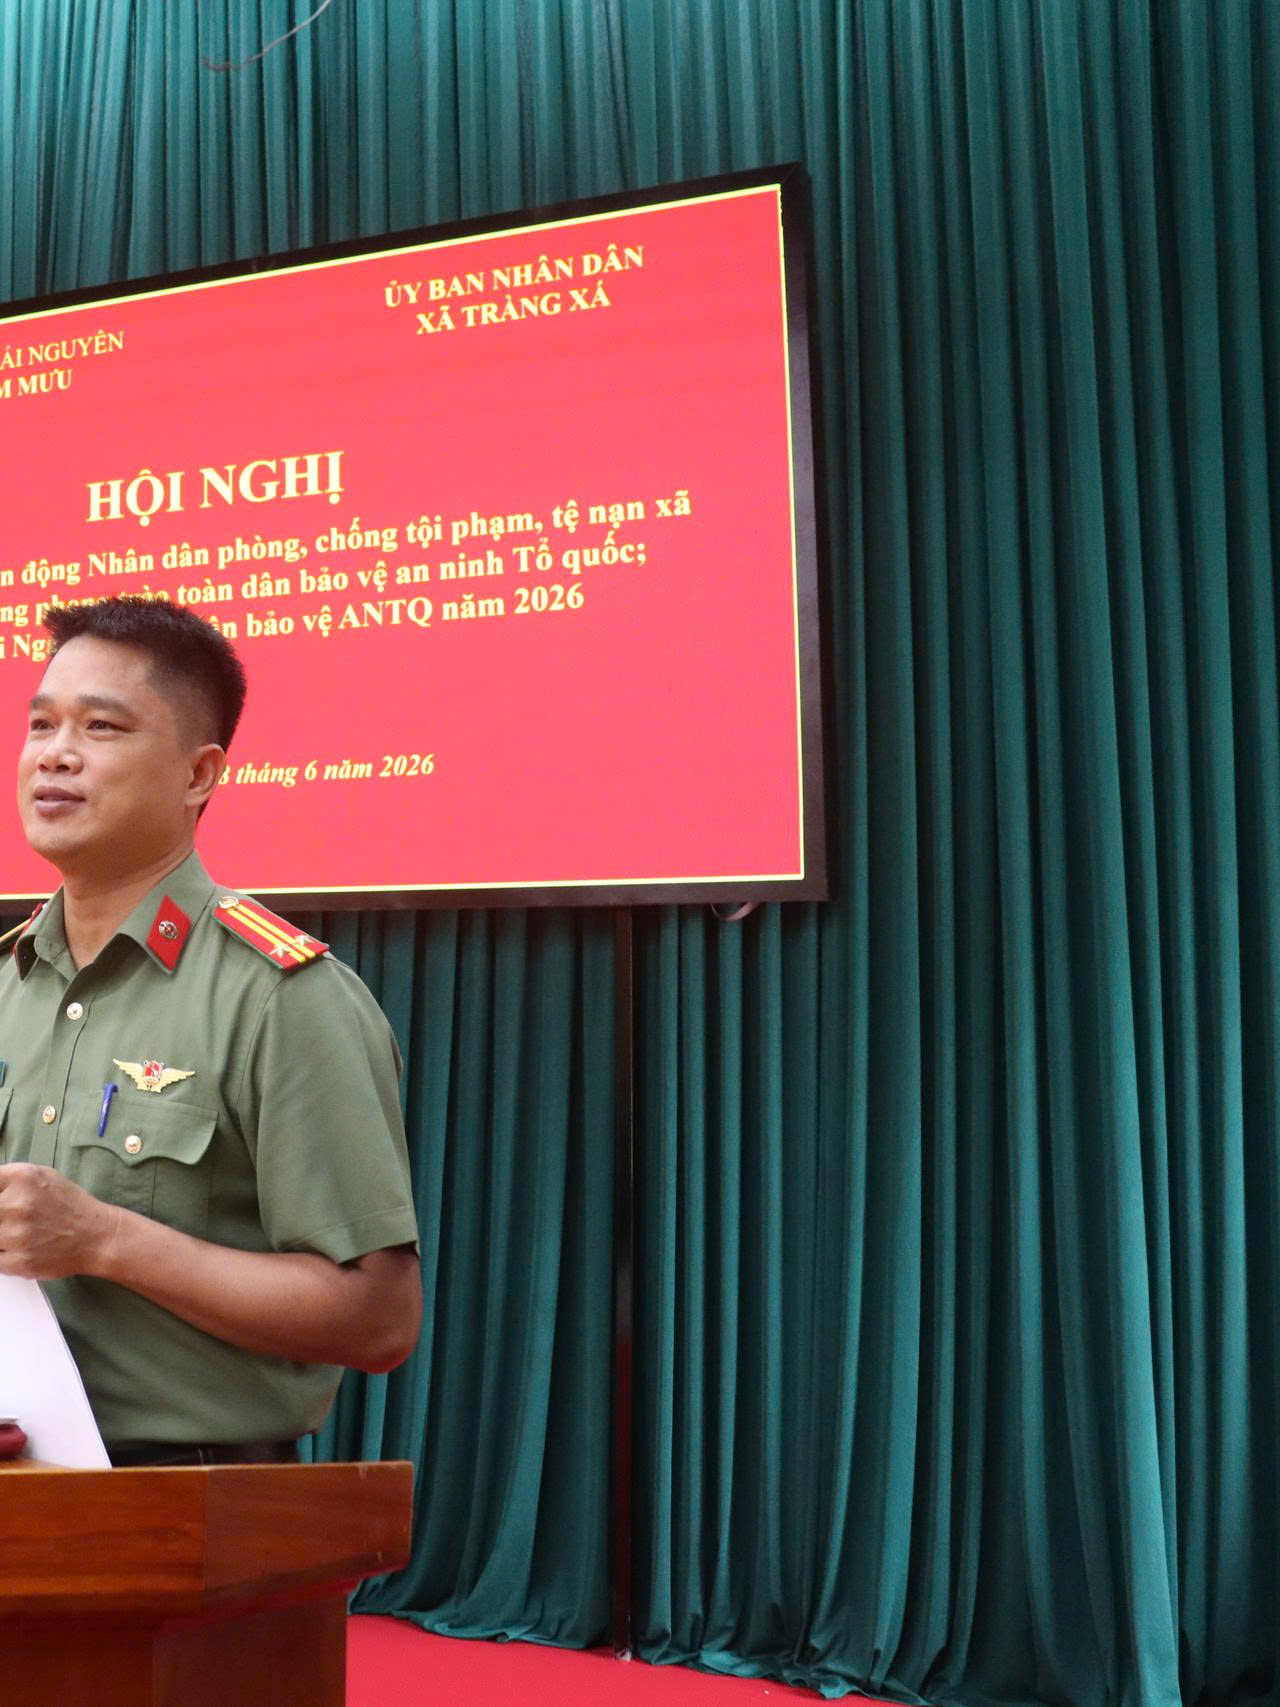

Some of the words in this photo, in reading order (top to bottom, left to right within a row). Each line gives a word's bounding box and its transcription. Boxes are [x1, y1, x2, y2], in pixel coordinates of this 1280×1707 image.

[384, 279, 422, 308] ỦY
[428, 271, 485, 301] BAN
[491, 254, 574, 291] NHÂN
[582, 243, 644, 277] DÂN
[415, 304, 456, 335] XÃ
[460, 292, 562, 328] TRÀNG
[568, 279, 611, 312] XÁ
[27, 329, 124, 366] NGUYÊN
[17, 368, 73, 397] MƯU
[85, 468, 185, 528] HỘI
[199, 450, 345, 509] NGHỊ
[20, 557, 81, 589] động
[87, 547, 155, 577] Nhân
[161, 541, 210, 570] dân
[217, 534, 309, 571] phòng,
[314, 516, 399, 554] chống
[405, 514, 443, 550] tội
[450, 511, 544, 547] phạm,
[551, 498, 580, 534] tệ
[588, 500, 646, 530] nạn
[655, 489, 692, 518] xã
[176, 577, 234, 606] toàn
[240, 571, 292, 600] dân
[298, 566, 350, 594] bảo
[356, 559, 388, 593] vệ
[395, 563, 431, 585] an
[439, 549, 505, 581] ninh
[511, 536, 554, 573] Tổ
[561, 529, 647, 576] quốc;
[12, 633, 57, 663] Ng
[245, 609, 295, 638] bảo
[301, 604, 333, 638] vệ
[337, 596, 433, 630] ANTQ
[441, 592, 506, 621] năm
[513, 581, 585, 615] 2026
[235, 761, 300, 789] tháng
[303, 759, 318, 782] 6
[322, 759, 374, 781] năm
[378, 753, 435, 778] 2026
